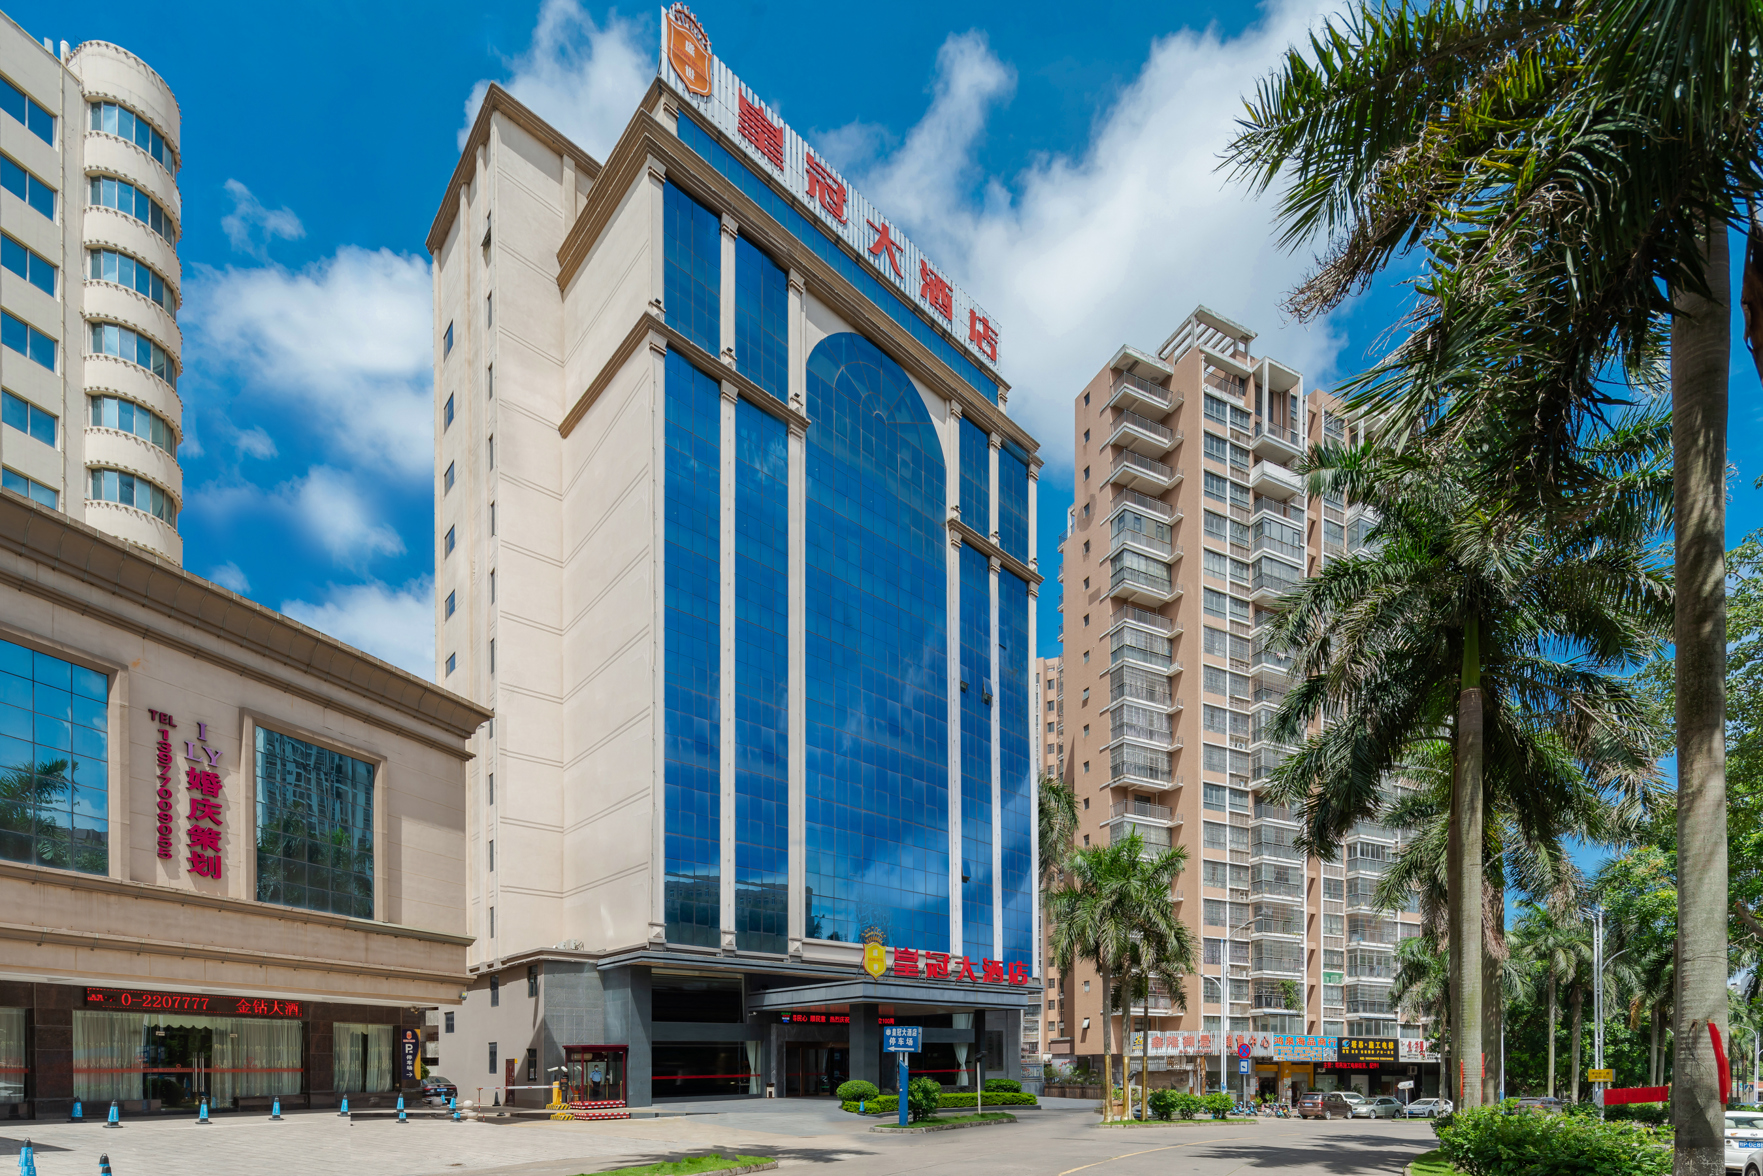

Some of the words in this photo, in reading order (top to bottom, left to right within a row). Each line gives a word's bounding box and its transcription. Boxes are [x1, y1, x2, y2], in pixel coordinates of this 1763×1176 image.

[738, 87, 999, 362] 皇冠大酒店
[148, 708, 178, 728] TEL
[197, 721, 208, 742] I
[184, 740, 223, 768] LY
[186, 766, 224, 880] 婚庆策划
[894, 945, 1029, 985] 皇冠大酒店
[235, 998, 299, 1016] 金钻大酒
[889, 1037, 913, 1046] 停车场
[891, 1028, 917, 1036] 皇冠大酒店
[405, 1044, 414, 1053] P
